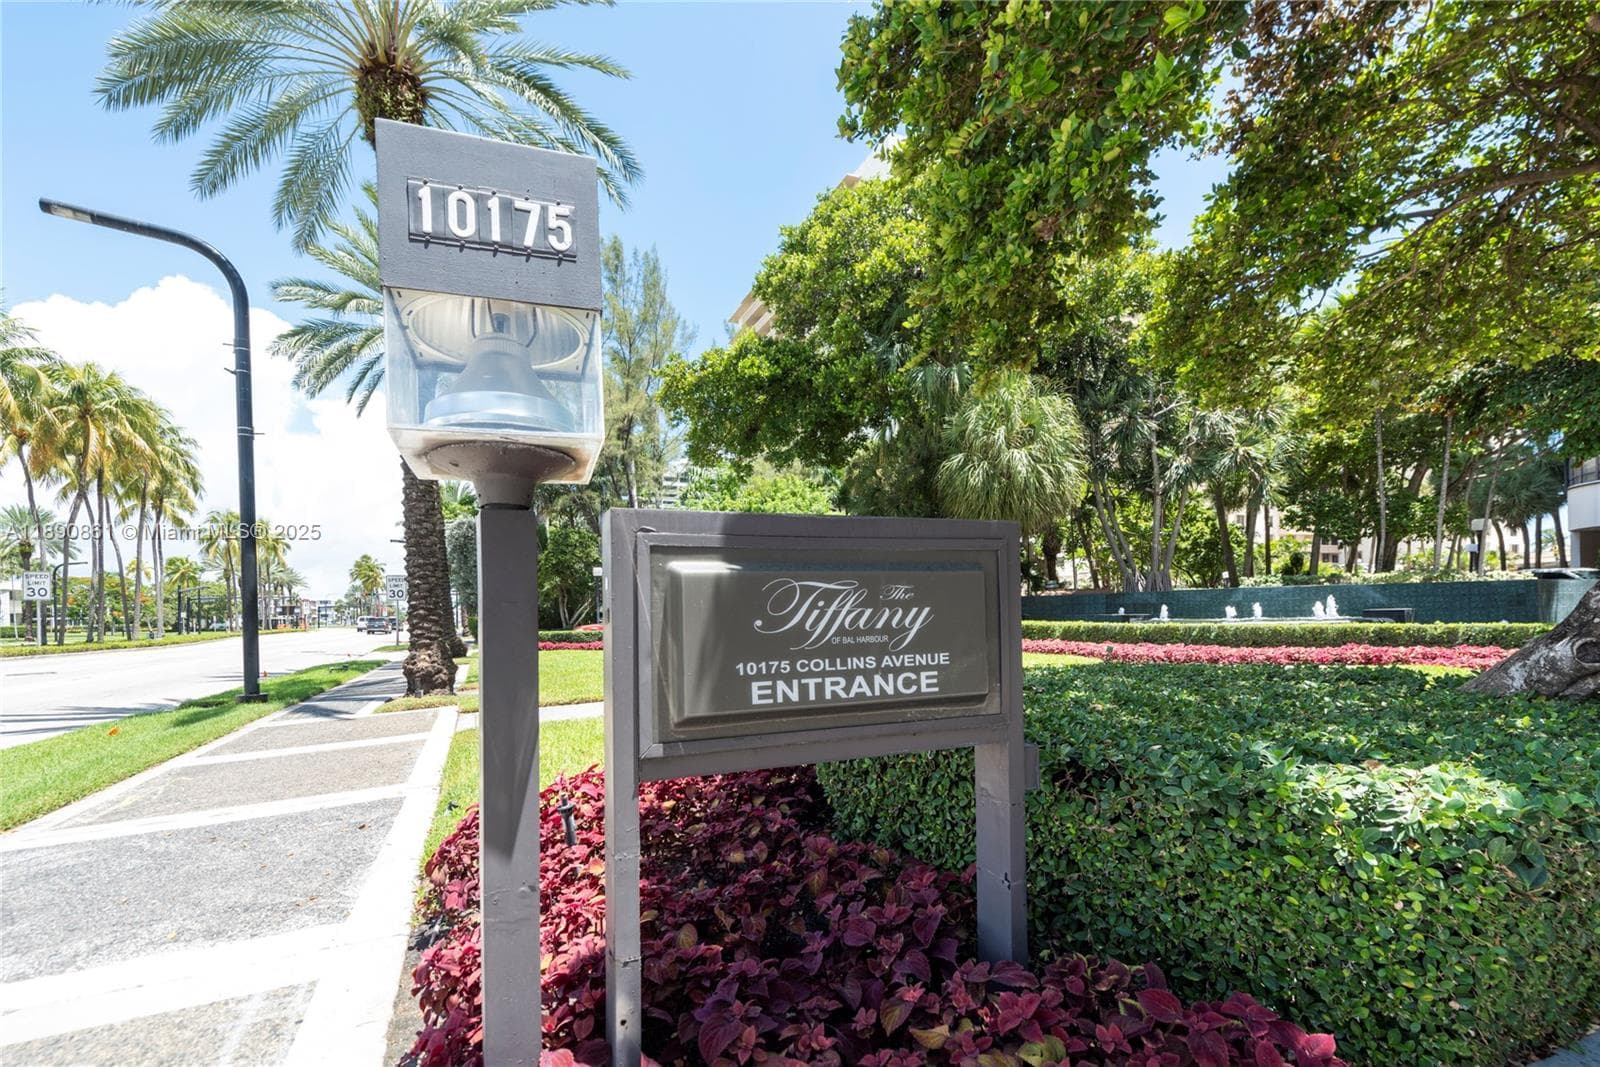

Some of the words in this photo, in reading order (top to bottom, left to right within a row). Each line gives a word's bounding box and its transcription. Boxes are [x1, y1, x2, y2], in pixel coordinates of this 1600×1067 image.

[418, 186, 573, 252] 10175
[26, 587, 48, 597] 30
[389, 589, 404, 599] 30
[880, 584, 916, 600] The
[753, 577, 935, 652] Tiffany
[831, 636, 841, 645] OF
[842, 636, 856, 644] BAL
[856, 634, 890, 643] HARBOUR
[736, 660, 791, 676] 10175
[796, 656, 877, 673] COLLINS
[880, 652, 951, 668] AVENUE
[751, 670, 940, 705] ENTRANCE
